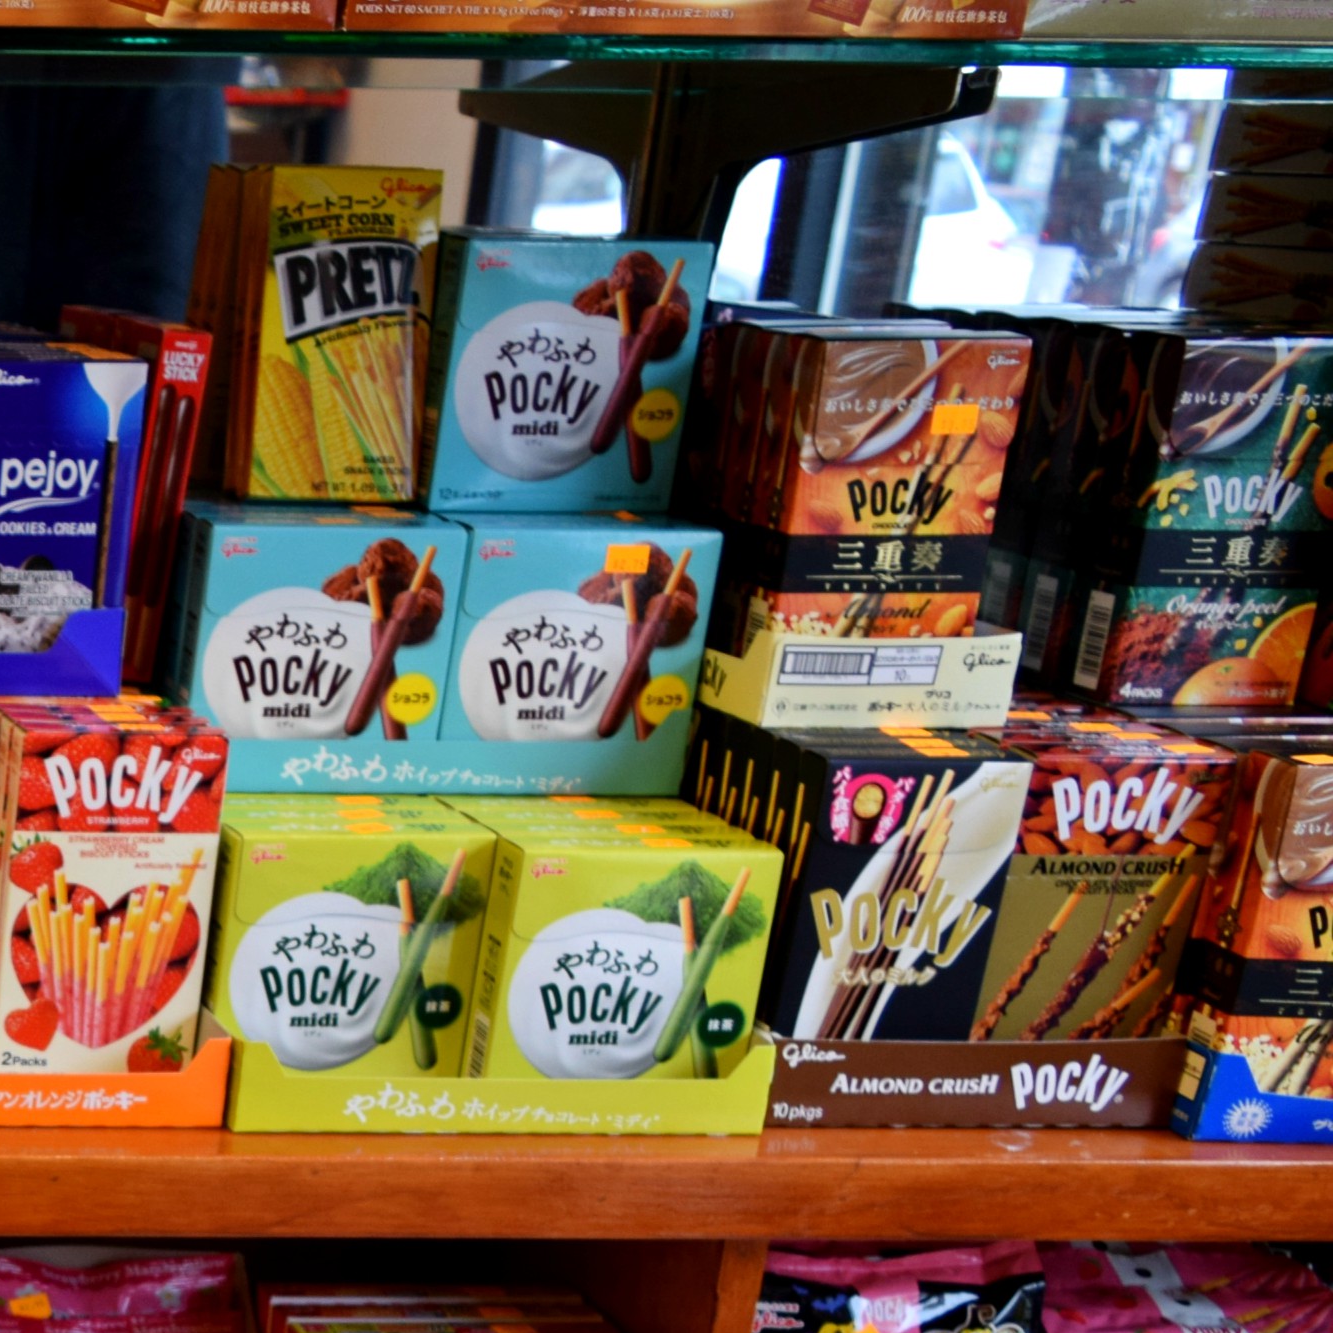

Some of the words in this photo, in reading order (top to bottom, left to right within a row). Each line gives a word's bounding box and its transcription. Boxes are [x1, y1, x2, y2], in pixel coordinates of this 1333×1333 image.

[348, 214, 394, 226] CORN
[163, 351, 205, 367] LUCKY
[162, 366, 200, 382] STICK
[511, 420, 559, 437] midi
[0, 451, 98, 497] pejoy
[847, 470, 952, 534] Pocky
[1204, 469, 1303, 525] Pocky
[834, 536, 943, 574] 三重奏
[1191, 535, 1288, 568] 三重奏
[489, 651, 607, 709] Pocky
[393, 691, 430, 705] ショコラ
[262, 701, 311, 719] midi
[44, 746, 201, 825] Pocky
[1053, 767, 1204, 845] Pocky
[1031, 858, 1118, 877] ALMOND
[260, 960, 381, 1016] Pocky
[707, 1017, 735, 1032] 抹茶
[568, 1030, 619, 1047] midi
[831, 1074, 924, 1094] ALMOND
